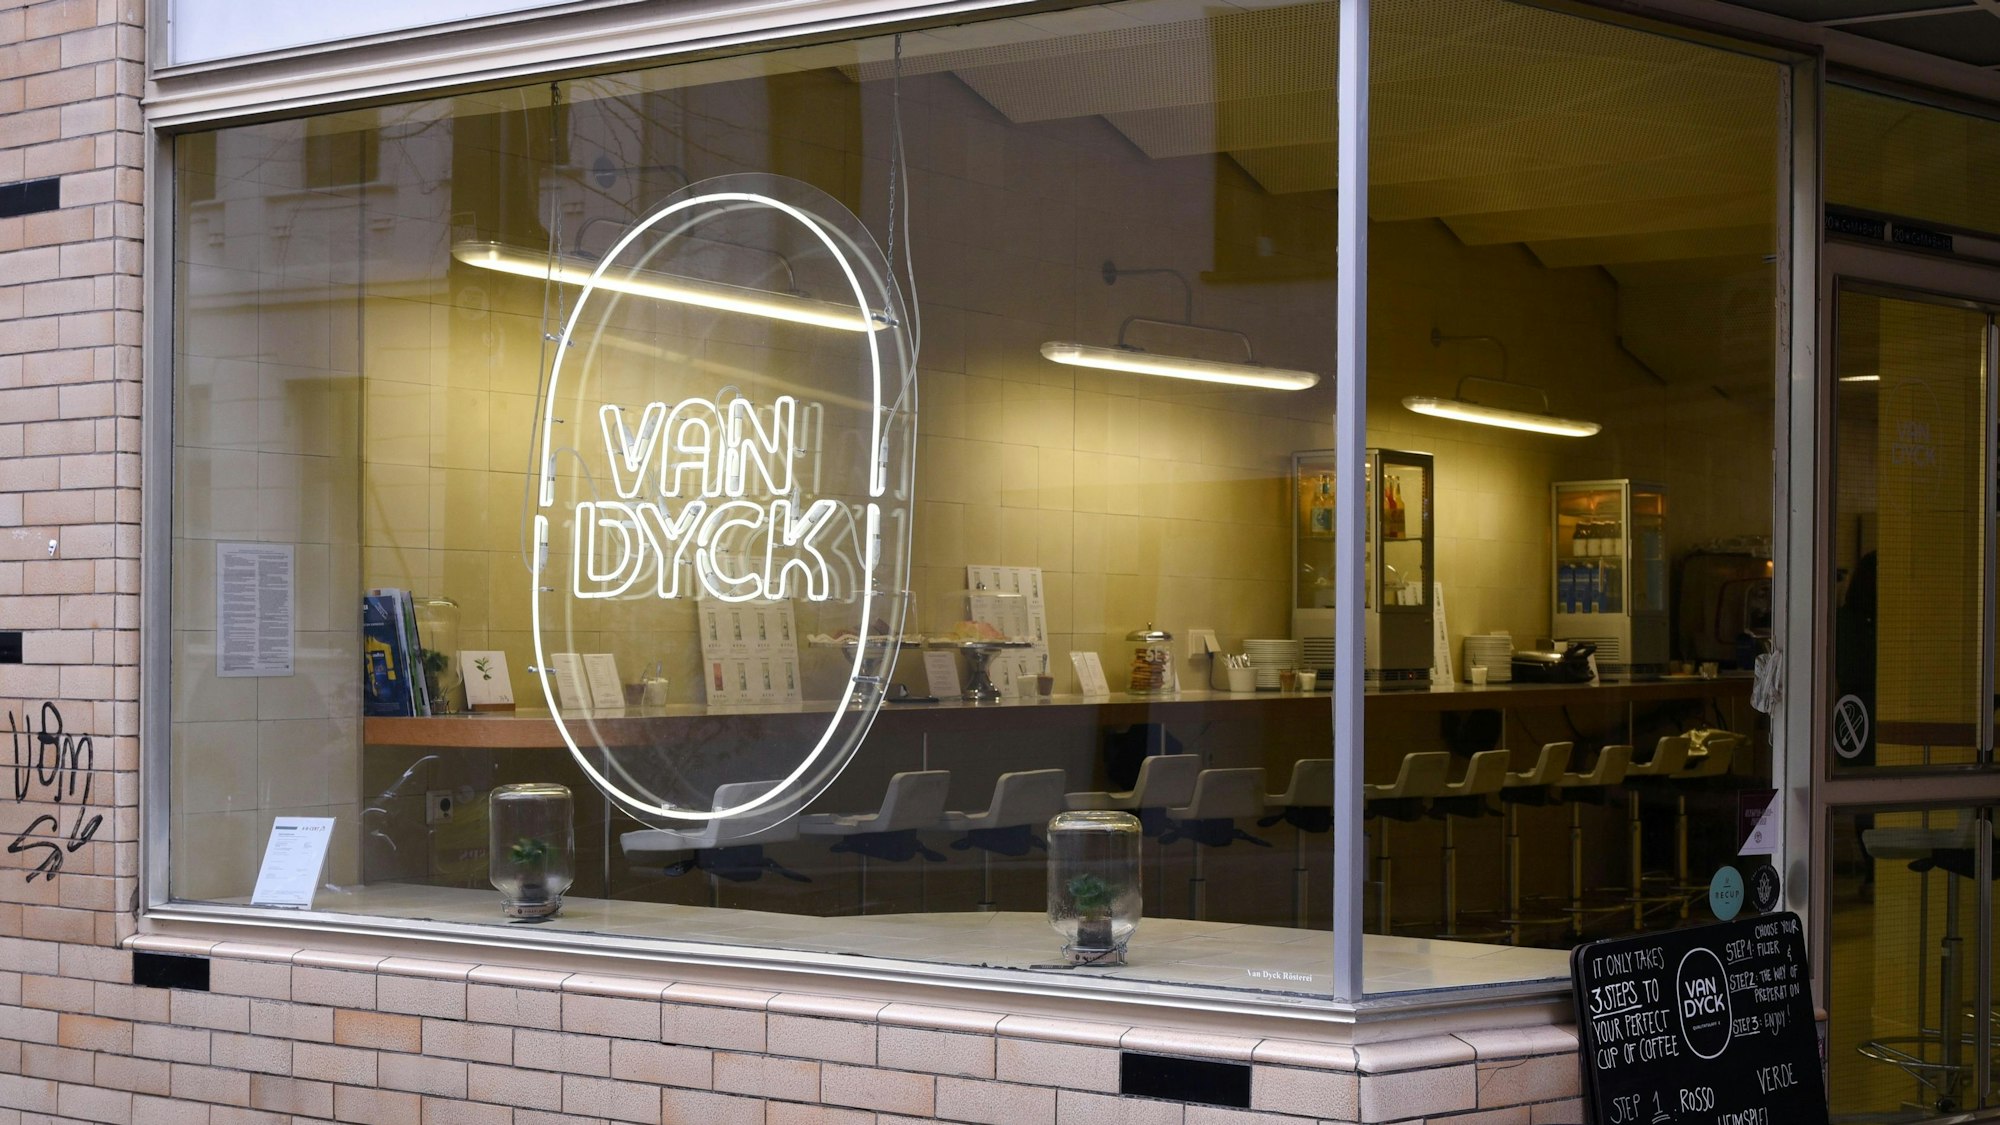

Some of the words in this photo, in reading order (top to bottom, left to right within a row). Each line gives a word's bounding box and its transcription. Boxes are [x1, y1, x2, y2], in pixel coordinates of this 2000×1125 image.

[600, 396, 795, 499] VAN
[573, 499, 837, 602] DYCK
[1715, 890, 1739, 899] RECUP
[1754, 922, 1778, 940] CHOOSE
[1781, 918, 1799, 934] YOUR
[1593, 958, 1603, 979] IT
[1606, 952, 1632, 976] ONLY
[1634, 946, 1664, 970] TAKES
[1726, 939, 1746, 962] STEP
[1756, 940, 1780, 957] FILTER
[1247, 969, 1260, 978] Van
[1262, 970, 1281, 980] Dyck
[1283, 971, 1313, 982] Rösterei
[1685, 976, 1717, 998] VAN
[1729, 971, 1749, 990] STEP
[1759, 969, 1772, 983] THE
[1773, 964, 1786, 981] WAY
[1789, 964, 1798, 979] OF
[1604, 980, 1638, 1011] STEPS
[1642, 978, 1659, 1003] TO
[1684, 993, 1725, 1018] DYCK
[1592, 1018, 1624, 1045] YOUR
[1625, 1010, 1670, 1037] PERFECT
[1732, 1017, 1751, 1035] STEP
[1597, 1047, 1618, 1070] CUP
[1624, 1043, 1636, 1064] OF
[1640, 1035, 1679, 1062] COFFEE
[1756, 1062, 1798, 1095] VERDE
[1610, 1093, 1641, 1124] STEP
[1679, 1086, 1715, 1113] ROSSO
